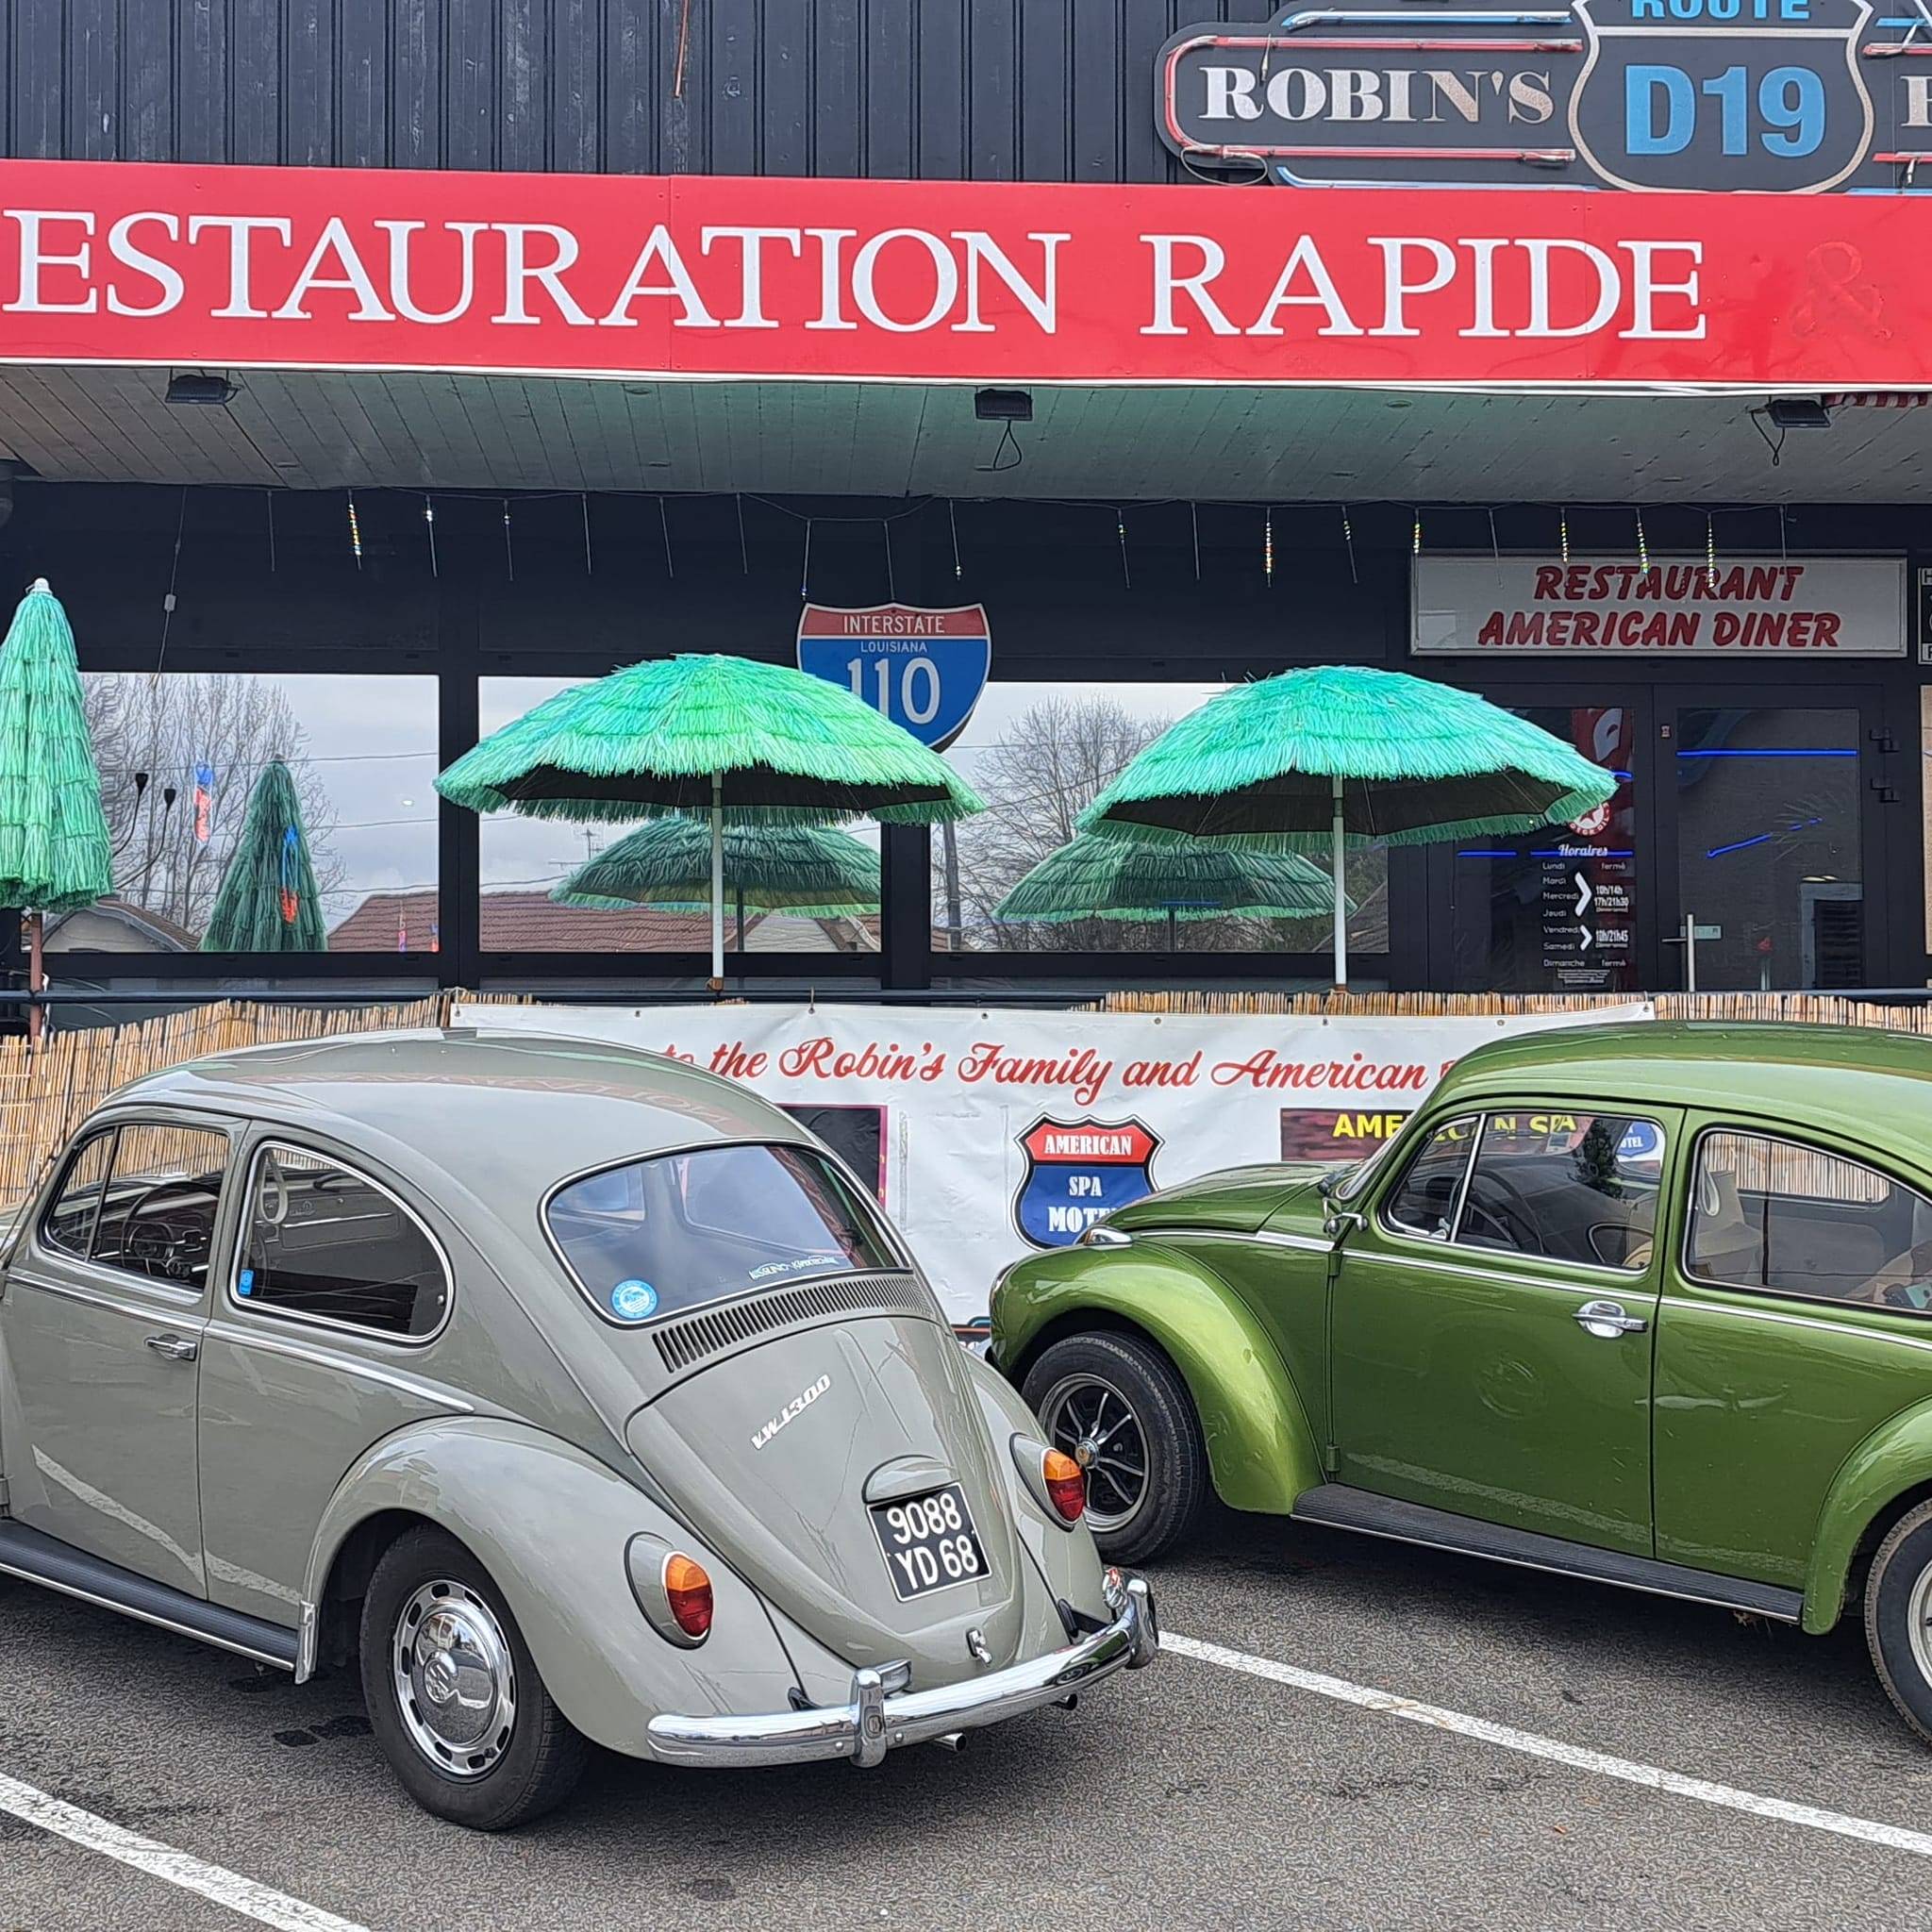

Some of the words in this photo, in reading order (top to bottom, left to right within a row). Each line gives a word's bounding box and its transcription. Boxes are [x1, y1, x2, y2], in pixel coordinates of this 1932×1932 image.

[1197, 67, 1557, 125] ROBIN'S
[1625, 64, 1826, 158] D19
[1140, 235, 1707, 340] RAPIDE
[1533, 564, 1804, 601] RESTAURANT
[843, 615, 945, 634] INTERSTATE
[859, 641, 928, 654] LOUISIANA
[1477, 610, 1701, 647] AMERICAN
[1712, 611, 1841, 648] DINER
[846, 657, 941, 725] 110
[1558, 844, 1608, 858] Horaires
[708, 1041, 768, 1078] the
[778, 1037, 946, 1082] Robin's
[958, 1042, 1114, 1107] Family
[1122, 1050, 1202, 1089] and
[1209, 1048, 1429, 1091] American
[1044, 1133, 1133, 1157] AMERICAN
[1068, 1175, 1103, 1197] SPA
[886, 1491, 963, 1545] 9088
[894, 1544, 940, 1591] YD
[940, 1534, 980, 1578] 68
